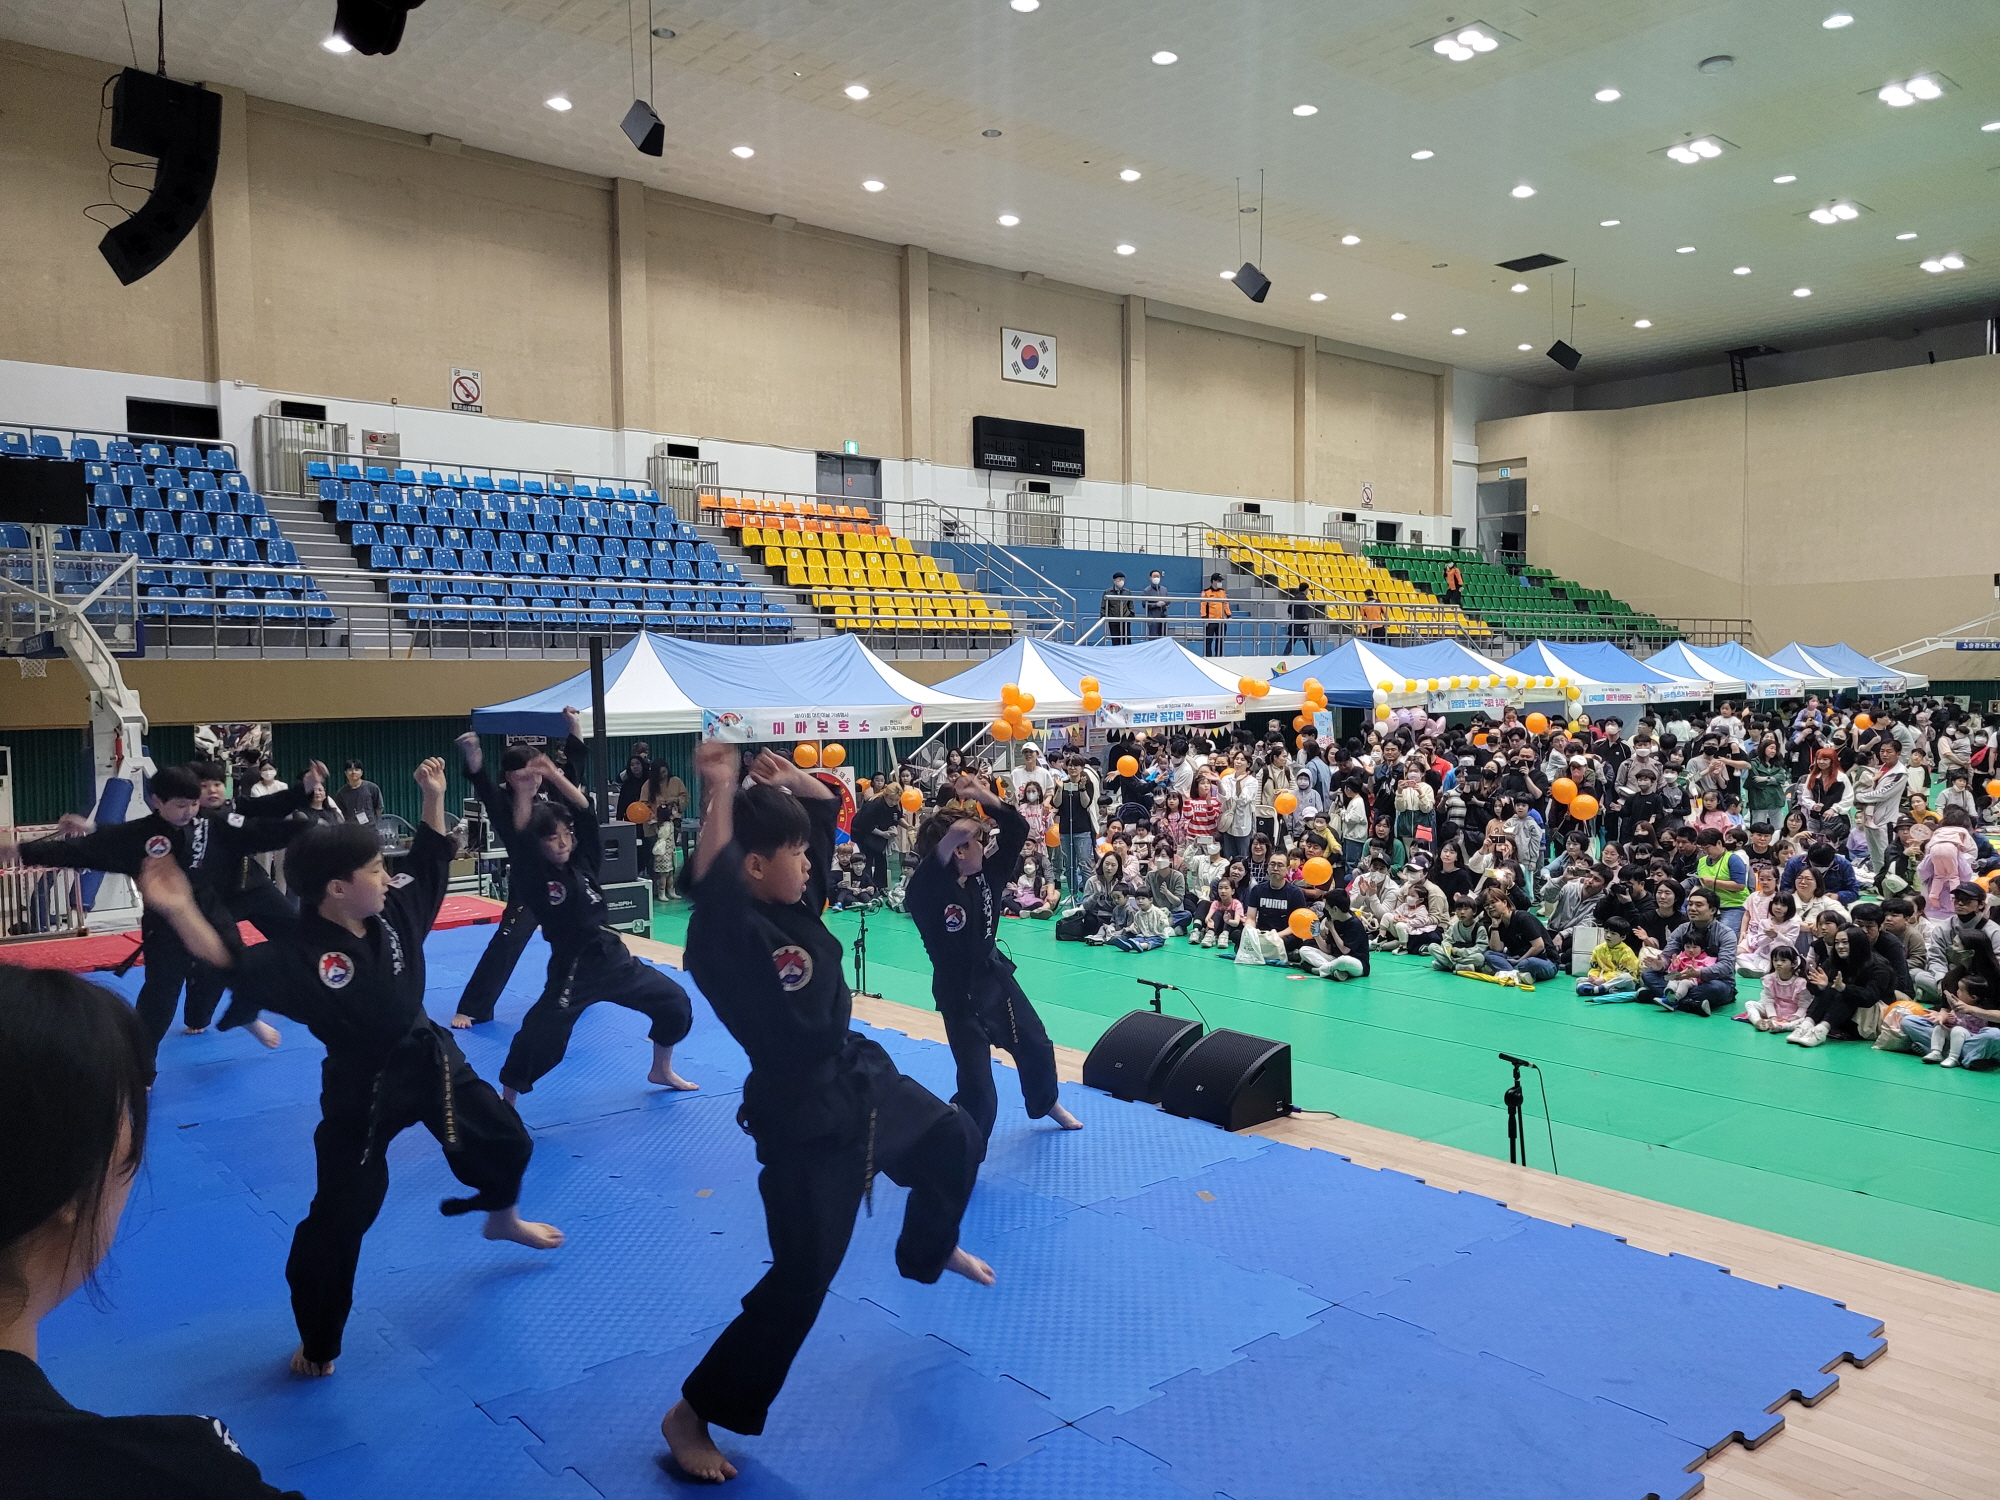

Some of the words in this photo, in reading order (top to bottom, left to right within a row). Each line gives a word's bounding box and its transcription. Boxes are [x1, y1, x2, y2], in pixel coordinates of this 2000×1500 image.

[912, 708, 920, 716] 11
[1133, 712, 1158, 723] 꼼지락
[1160, 711, 1184, 722] 꼼지락
[1186, 709, 1216, 720] 만들기터
[1260, 898, 1288, 909] PUMA
